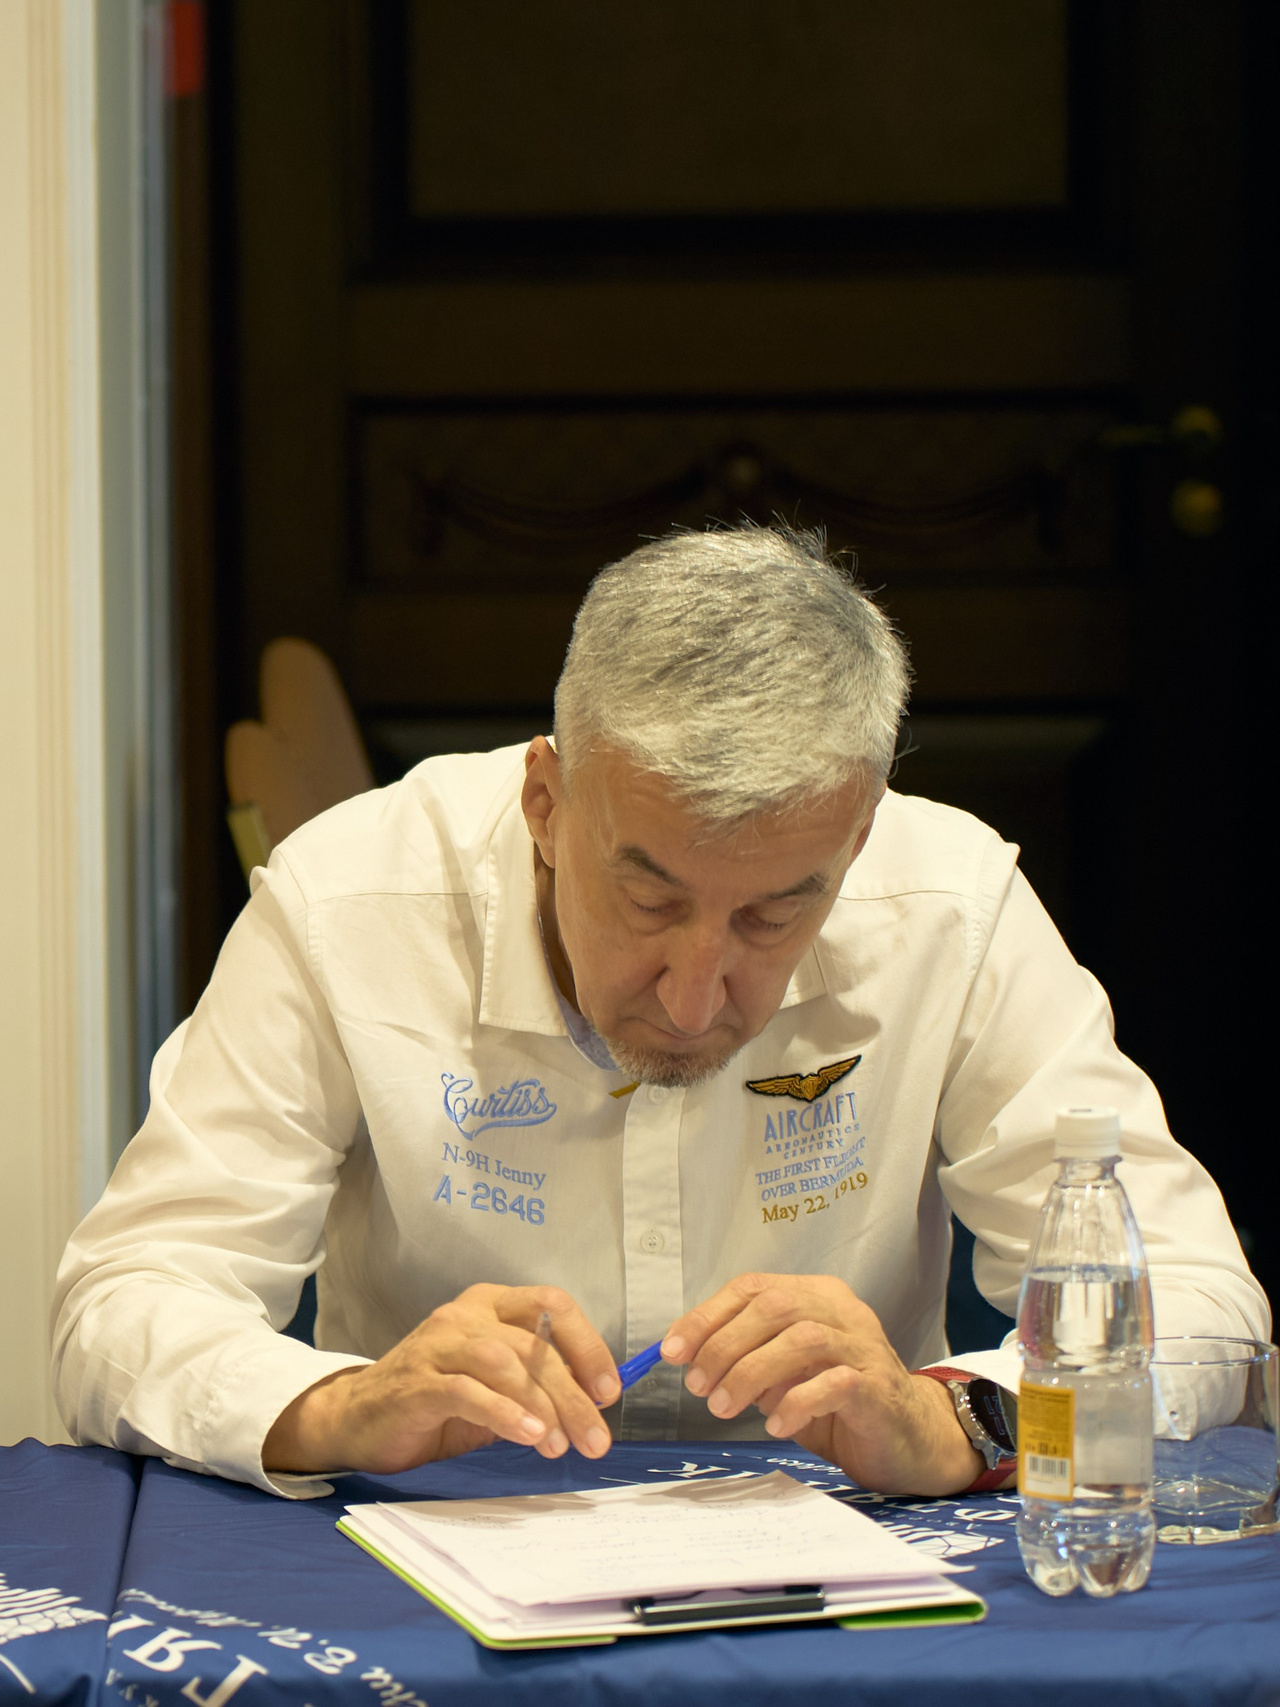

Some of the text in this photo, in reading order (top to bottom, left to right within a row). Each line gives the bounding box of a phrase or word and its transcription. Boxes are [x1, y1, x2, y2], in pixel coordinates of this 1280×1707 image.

[441, 1072, 557, 1141] Curtiss
[764, 1092, 856, 1142] AIRCRAFT
[766, 1123, 860, 1154] AERONAUTICS
[784, 1138, 844, 1159] CENTURY
[441, 1142, 546, 1191] N-9H Jenny
[756, 1168, 781, 1185] THE
[783, 1158, 821, 1179] FIRST
[761, 1157, 864, 1201] OVER BERMUDA
[762, 1171, 869, 1224] May 22, 1919
